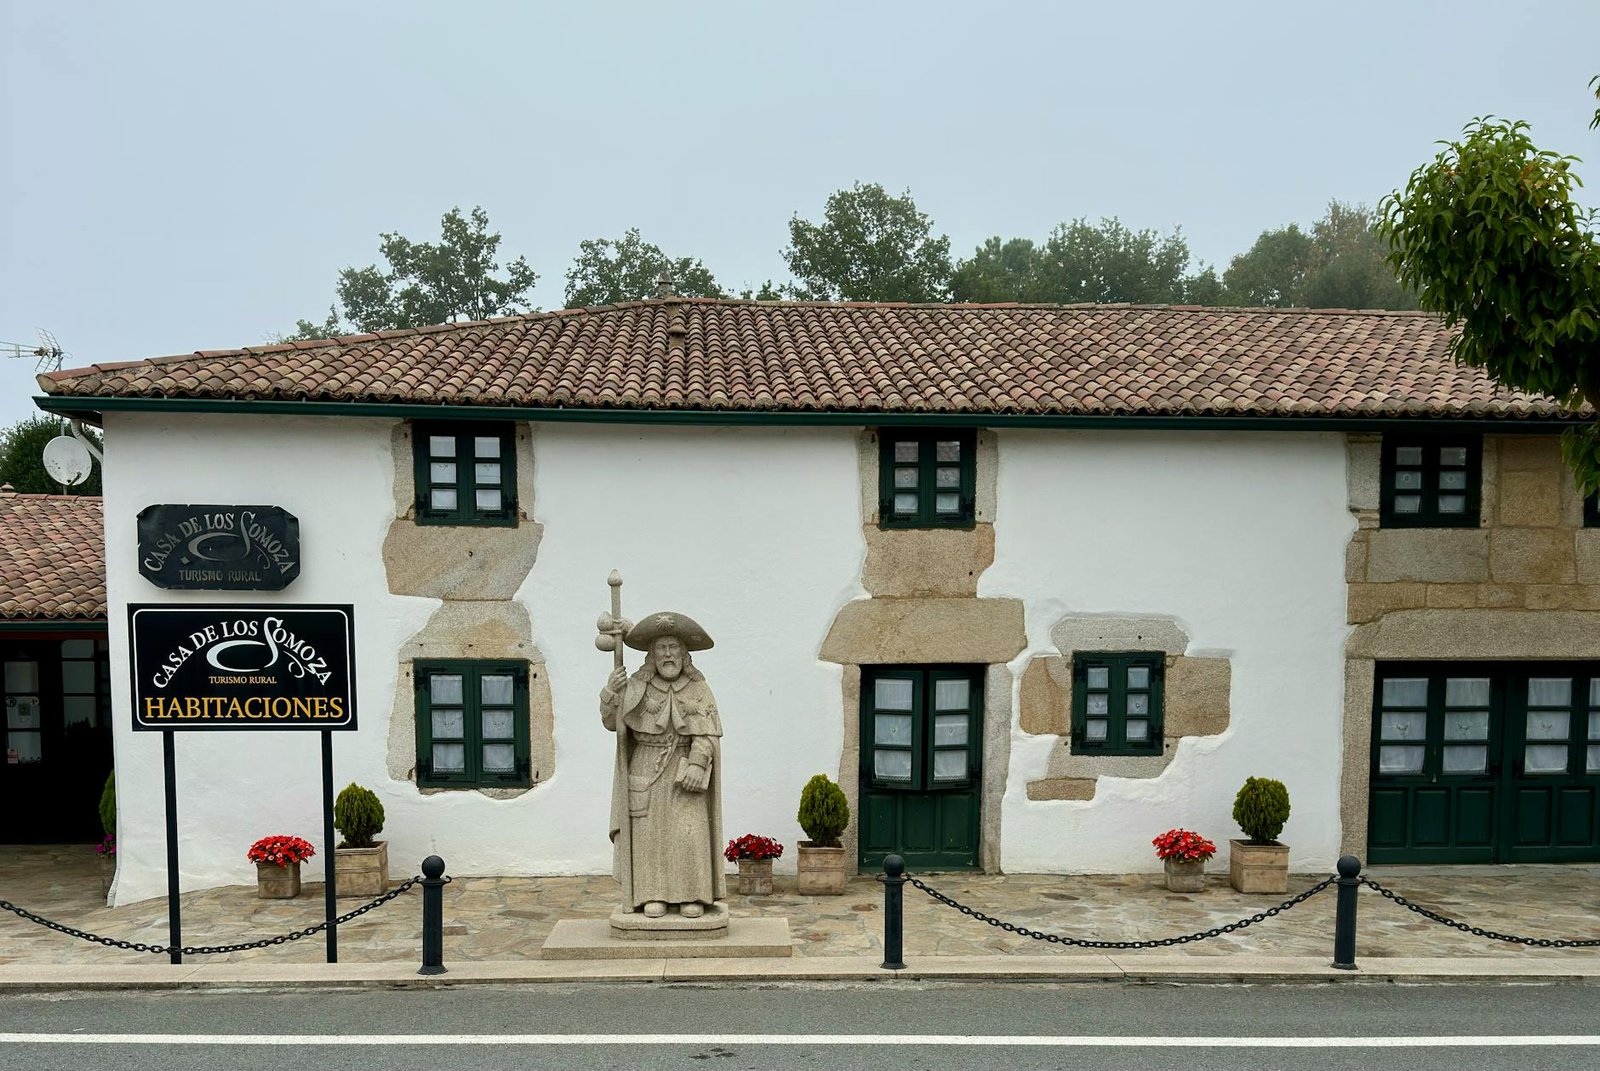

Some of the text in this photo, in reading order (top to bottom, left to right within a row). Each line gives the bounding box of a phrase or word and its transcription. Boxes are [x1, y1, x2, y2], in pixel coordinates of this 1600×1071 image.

[144, 510, 297, 574] CASA DE LOS SOMOZA
[179, 569, 262, 582] TURISMO RURAL
[153, 616, 332, 689] CASA DE LOS SOMOZA
[208, 676, 278, 684] TURISMO RURAL
[144, 697, 344, 719] HABITACIONES
